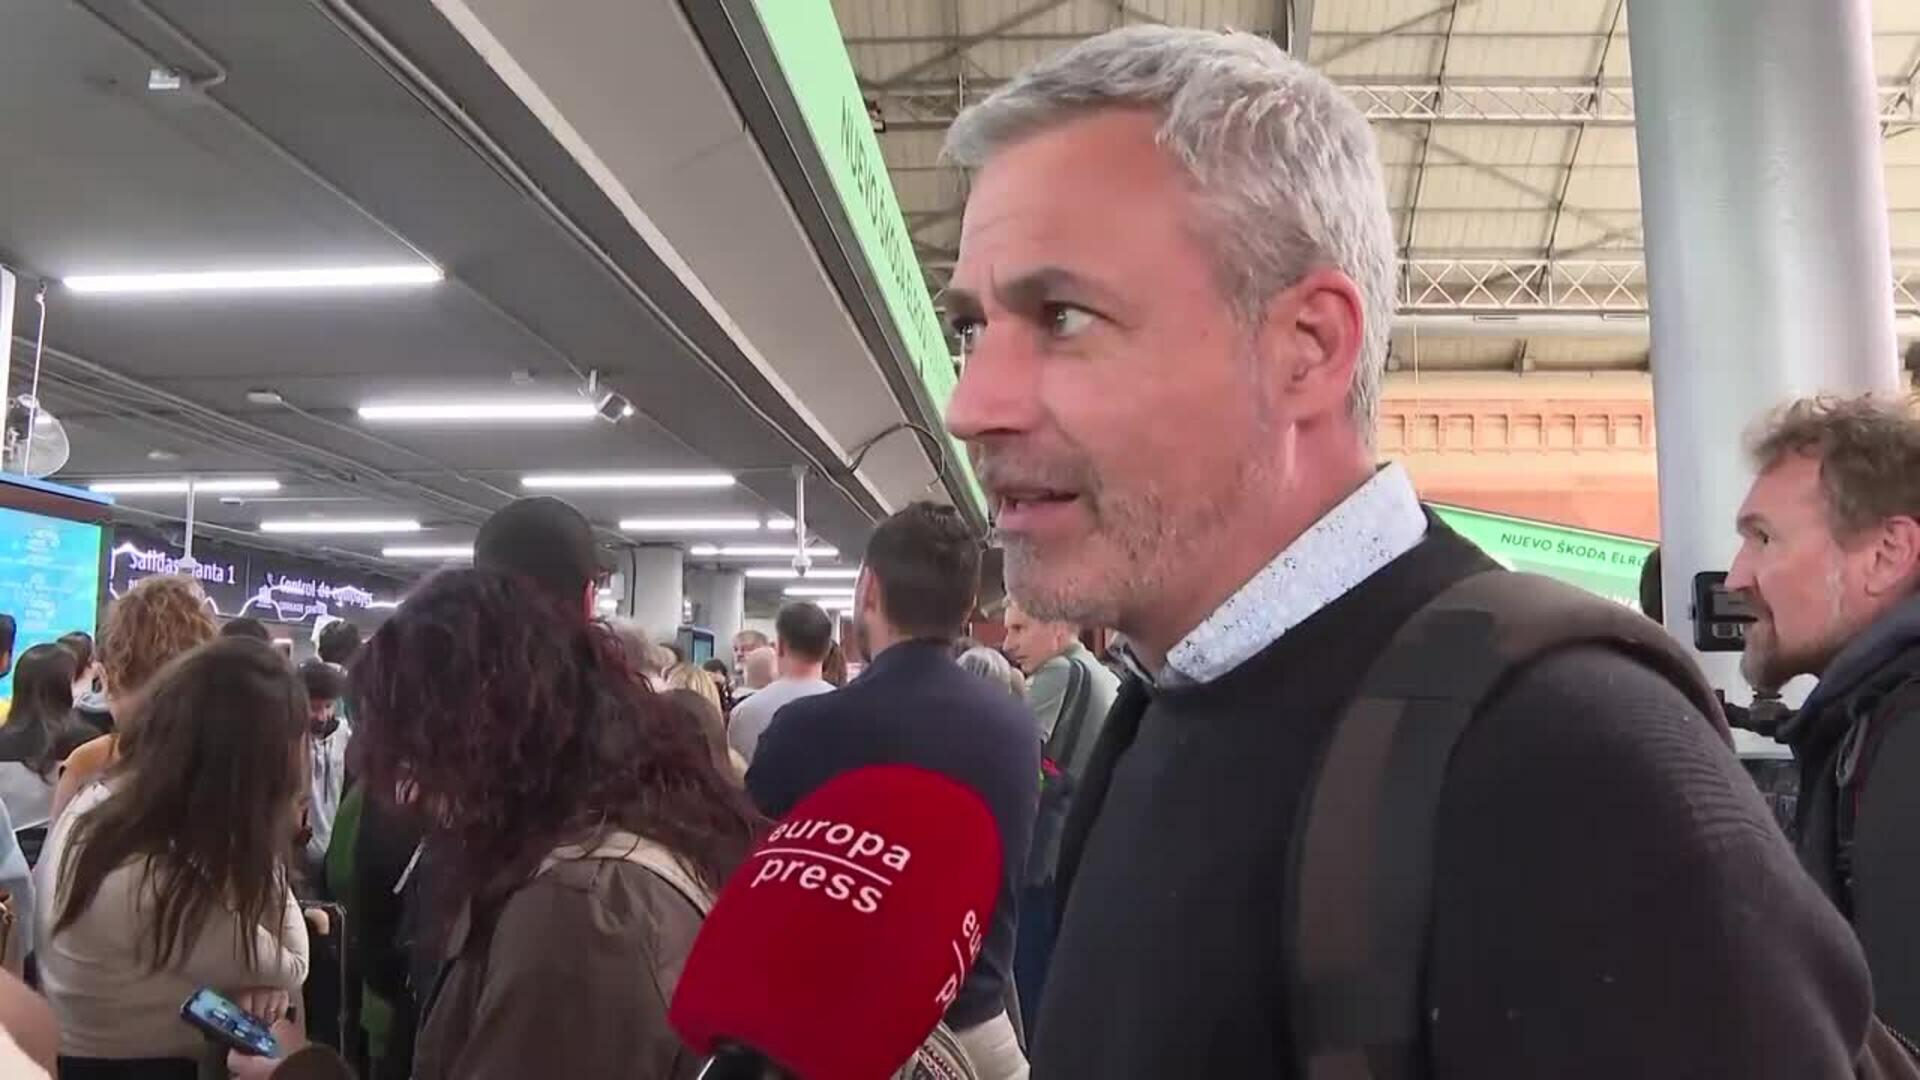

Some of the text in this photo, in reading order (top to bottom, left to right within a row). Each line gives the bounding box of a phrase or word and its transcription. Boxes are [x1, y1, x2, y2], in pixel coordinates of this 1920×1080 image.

[841, 96, 877, 225] NUEVO
[1500, 532, 1552, 551] NUEVO
[1556, 539, 1606, 561] ŠKODA
[227, 564, 236, 584] 1
[279, 575, 315, 597] Control
[767, 818, 912, 872] europa
[751, 857, 883, 914] press
